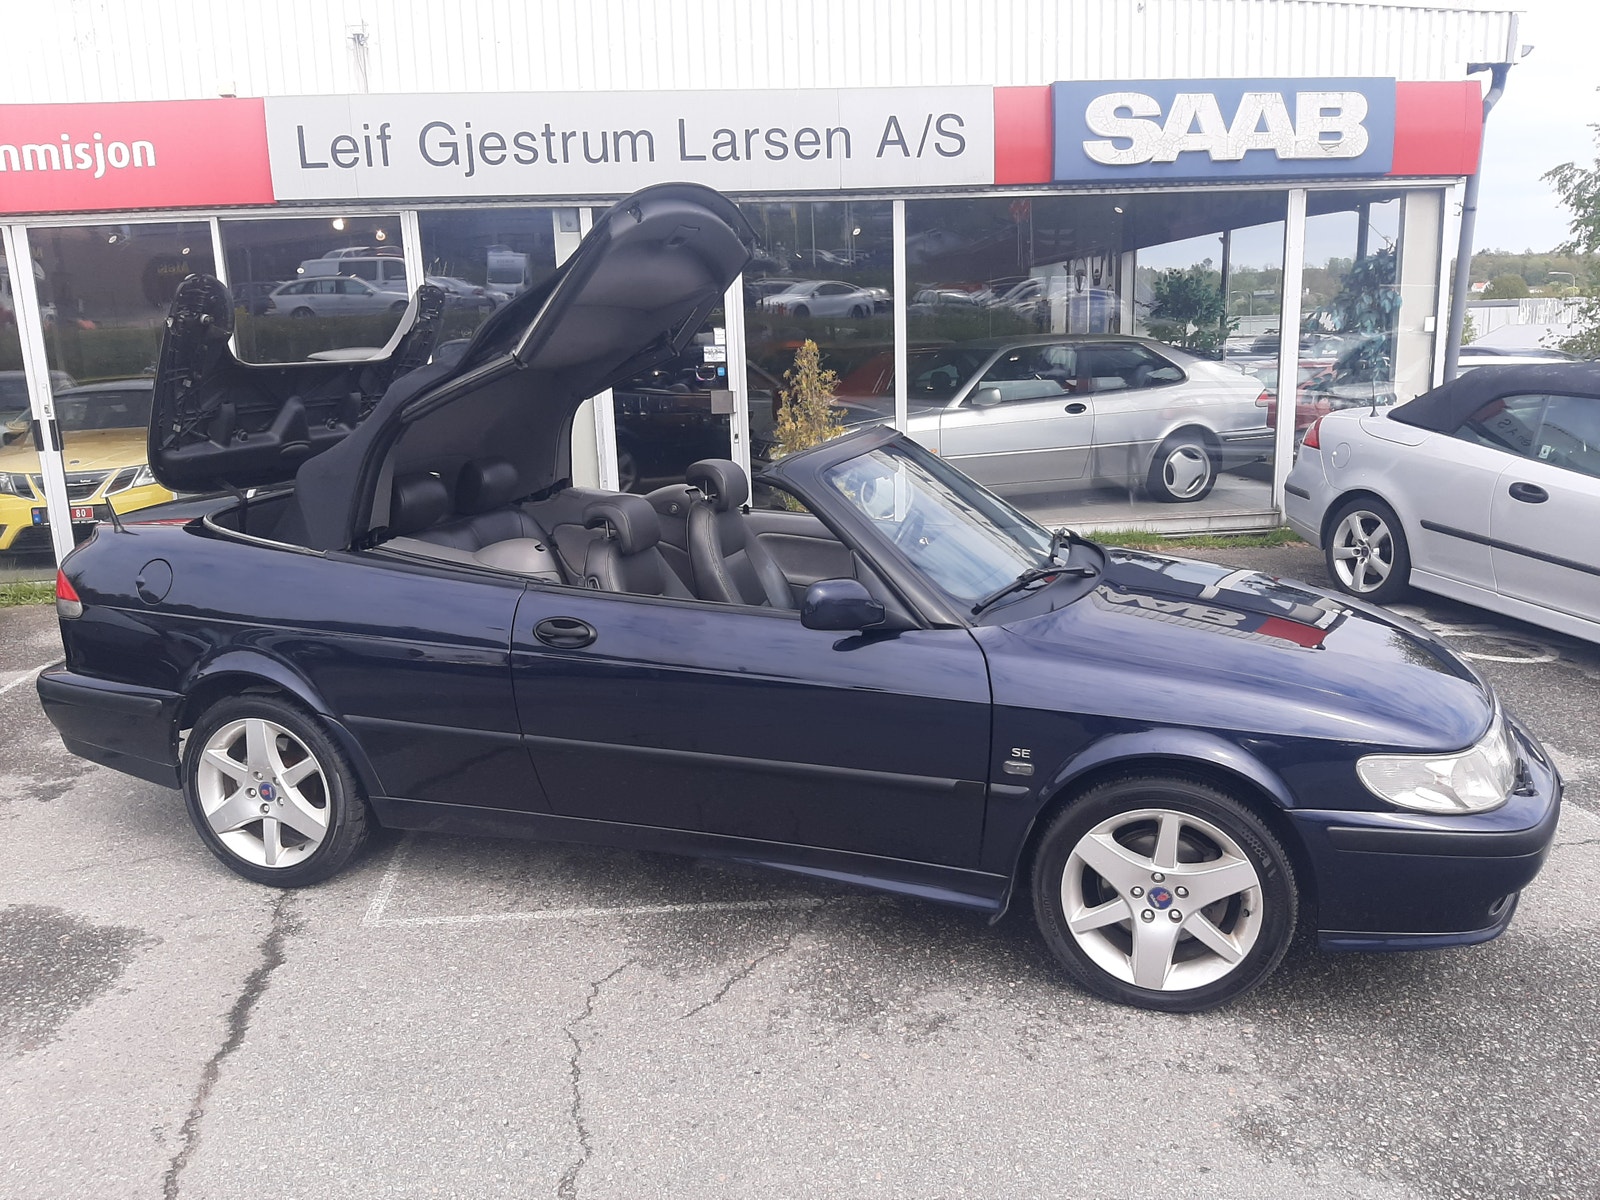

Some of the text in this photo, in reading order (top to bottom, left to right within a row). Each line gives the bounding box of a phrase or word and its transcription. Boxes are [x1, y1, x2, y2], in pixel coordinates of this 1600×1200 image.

[296, 113, 966, 177] Leif Gjestrum Larsen A/S
[1082, 91, 1369, 165] SAAB
[75, 508, 86, 518] 80
[1011, 747, 1031, 759] SE
